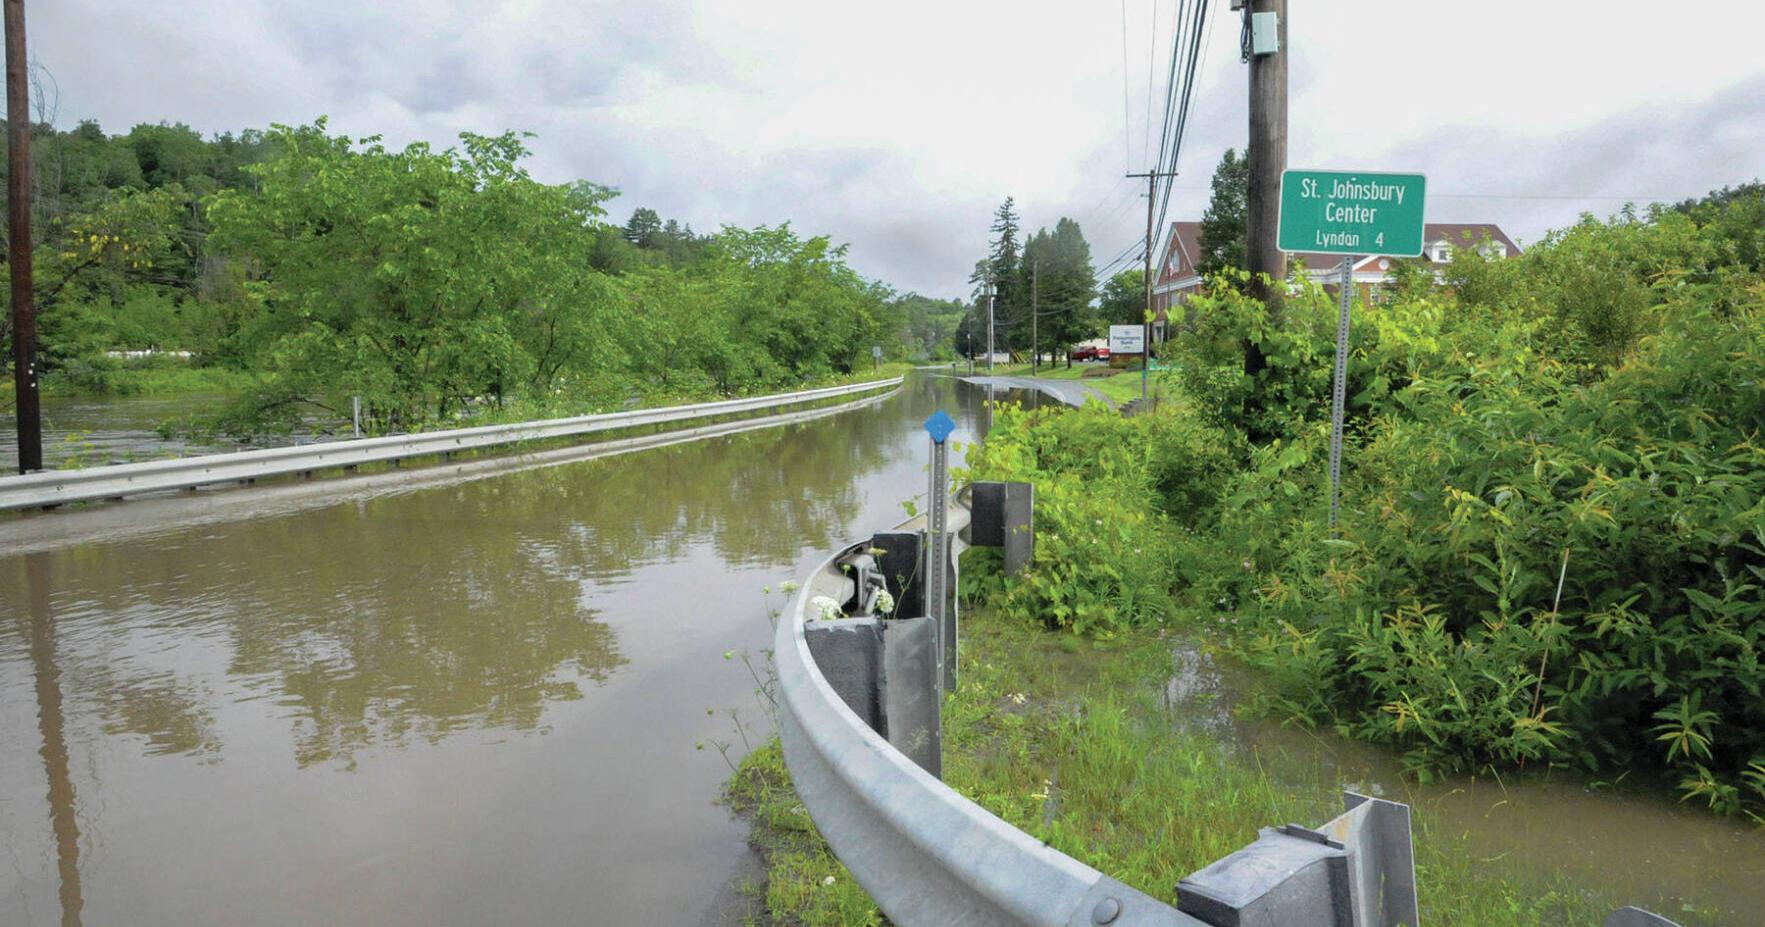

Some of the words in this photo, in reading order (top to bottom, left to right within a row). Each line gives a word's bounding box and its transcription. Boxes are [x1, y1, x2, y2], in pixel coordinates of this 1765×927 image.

[1301, 178, 1321, 198] St.
[1328, 178, 1405, 205] Johnsbury
[1326, 202, 1377, 223] Center
[1375, 231, 1384, 248] 4
